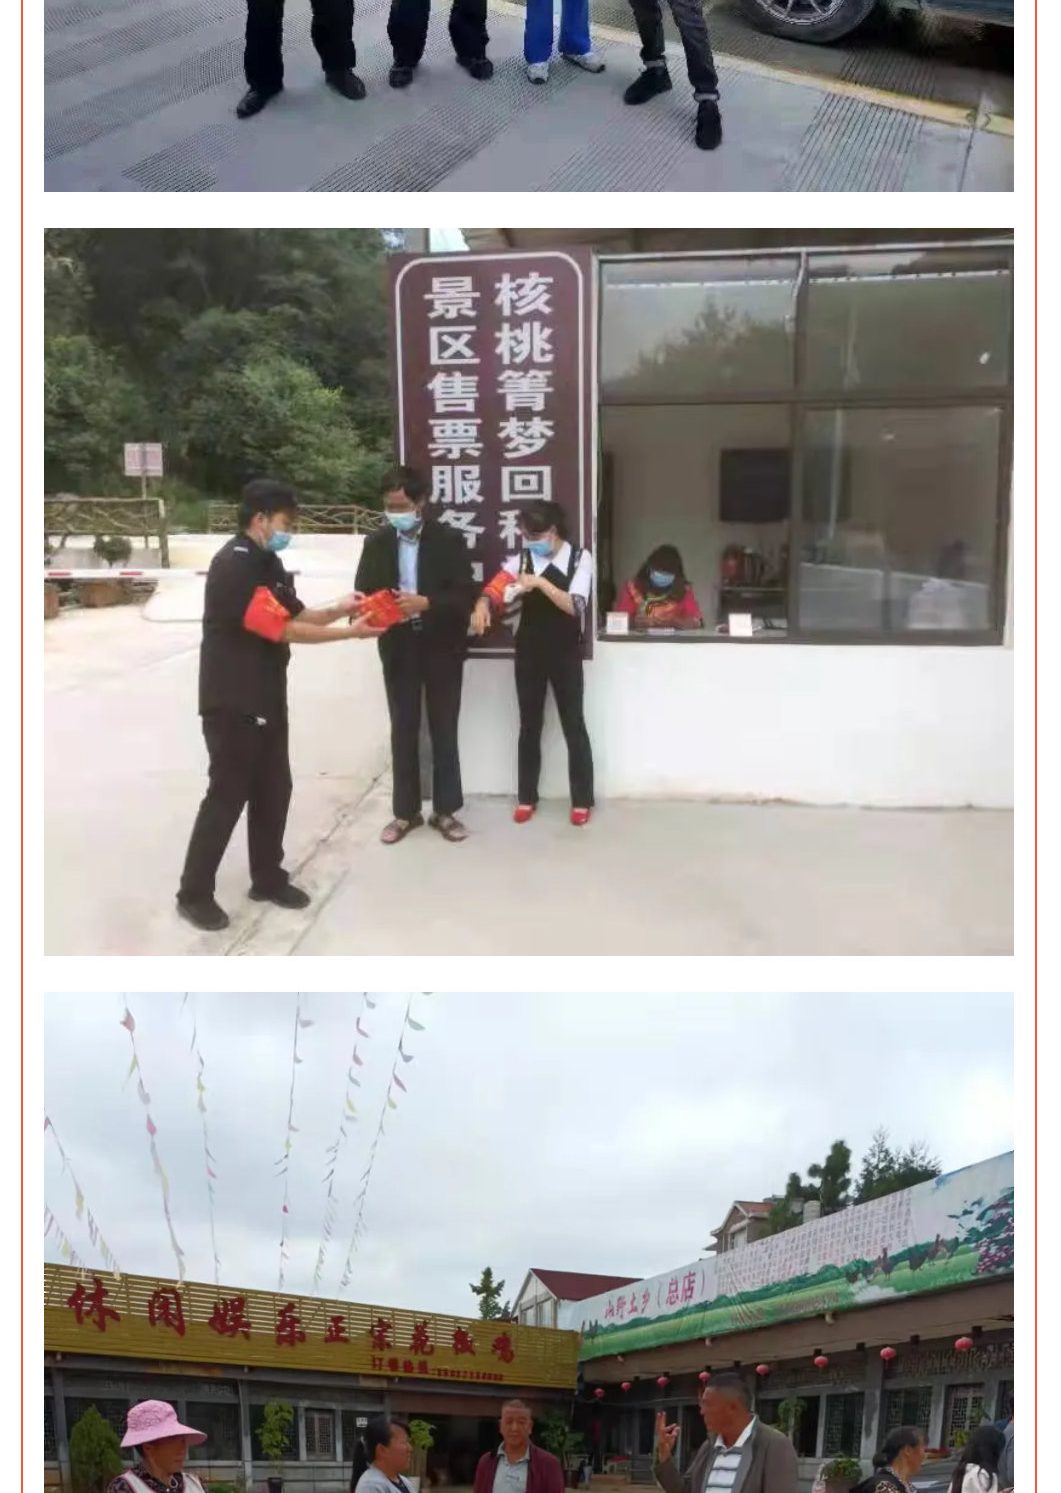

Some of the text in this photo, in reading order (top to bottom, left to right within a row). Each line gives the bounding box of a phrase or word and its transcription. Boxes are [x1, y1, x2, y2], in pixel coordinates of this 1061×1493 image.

[423, 275, 486, 634] 景区售票服务
